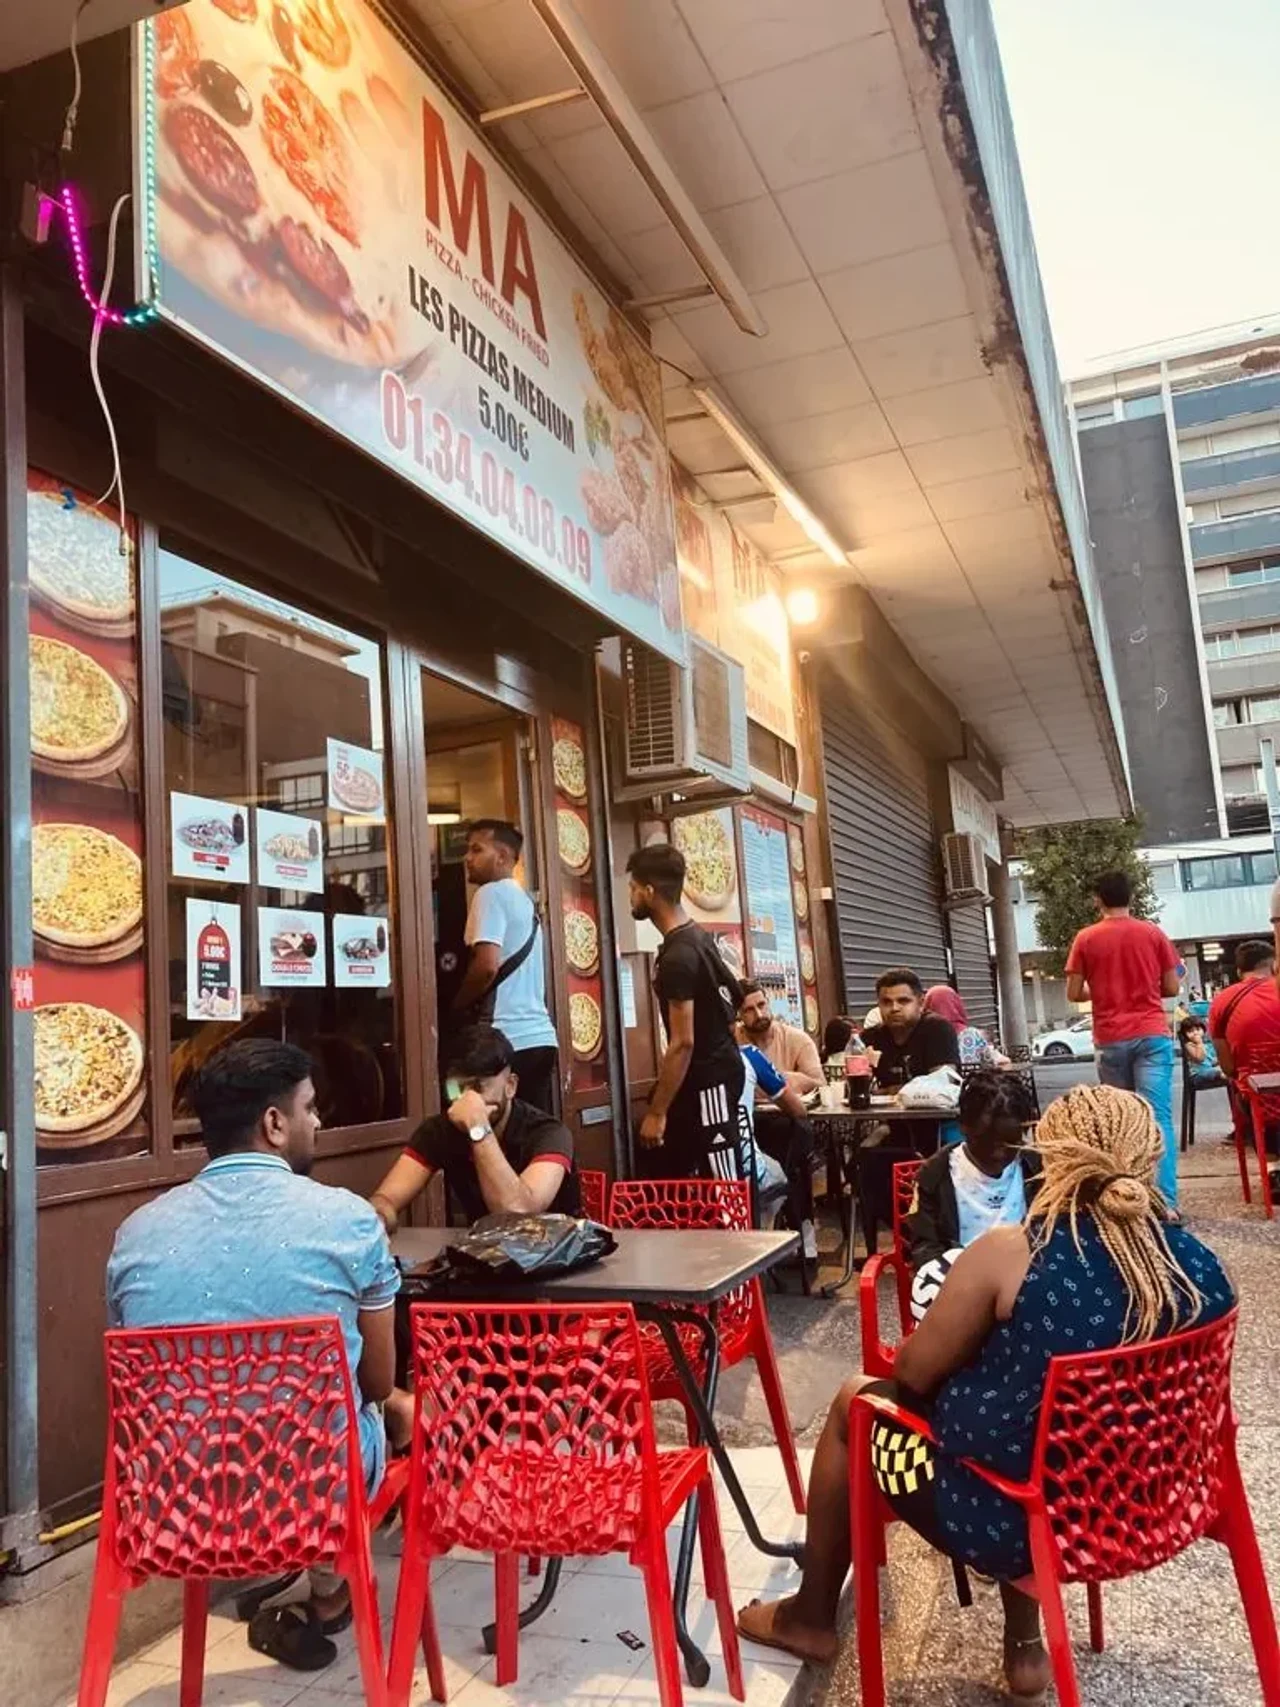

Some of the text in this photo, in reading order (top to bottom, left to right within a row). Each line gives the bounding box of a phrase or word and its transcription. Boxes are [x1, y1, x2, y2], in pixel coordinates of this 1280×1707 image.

[422, 96, 548, 344] MA
[426, 229, 463, 281] PIZZA
[472, 277, 520, 340] CHICKEN
[521, 326, 550, 369] FRIED
[408, 264, 576, 454] LES PIZZAS MEDIUM
[478, 385, 530, 462] 5.00€
[381, 370, 592, 586] 01.34.04.08.09
